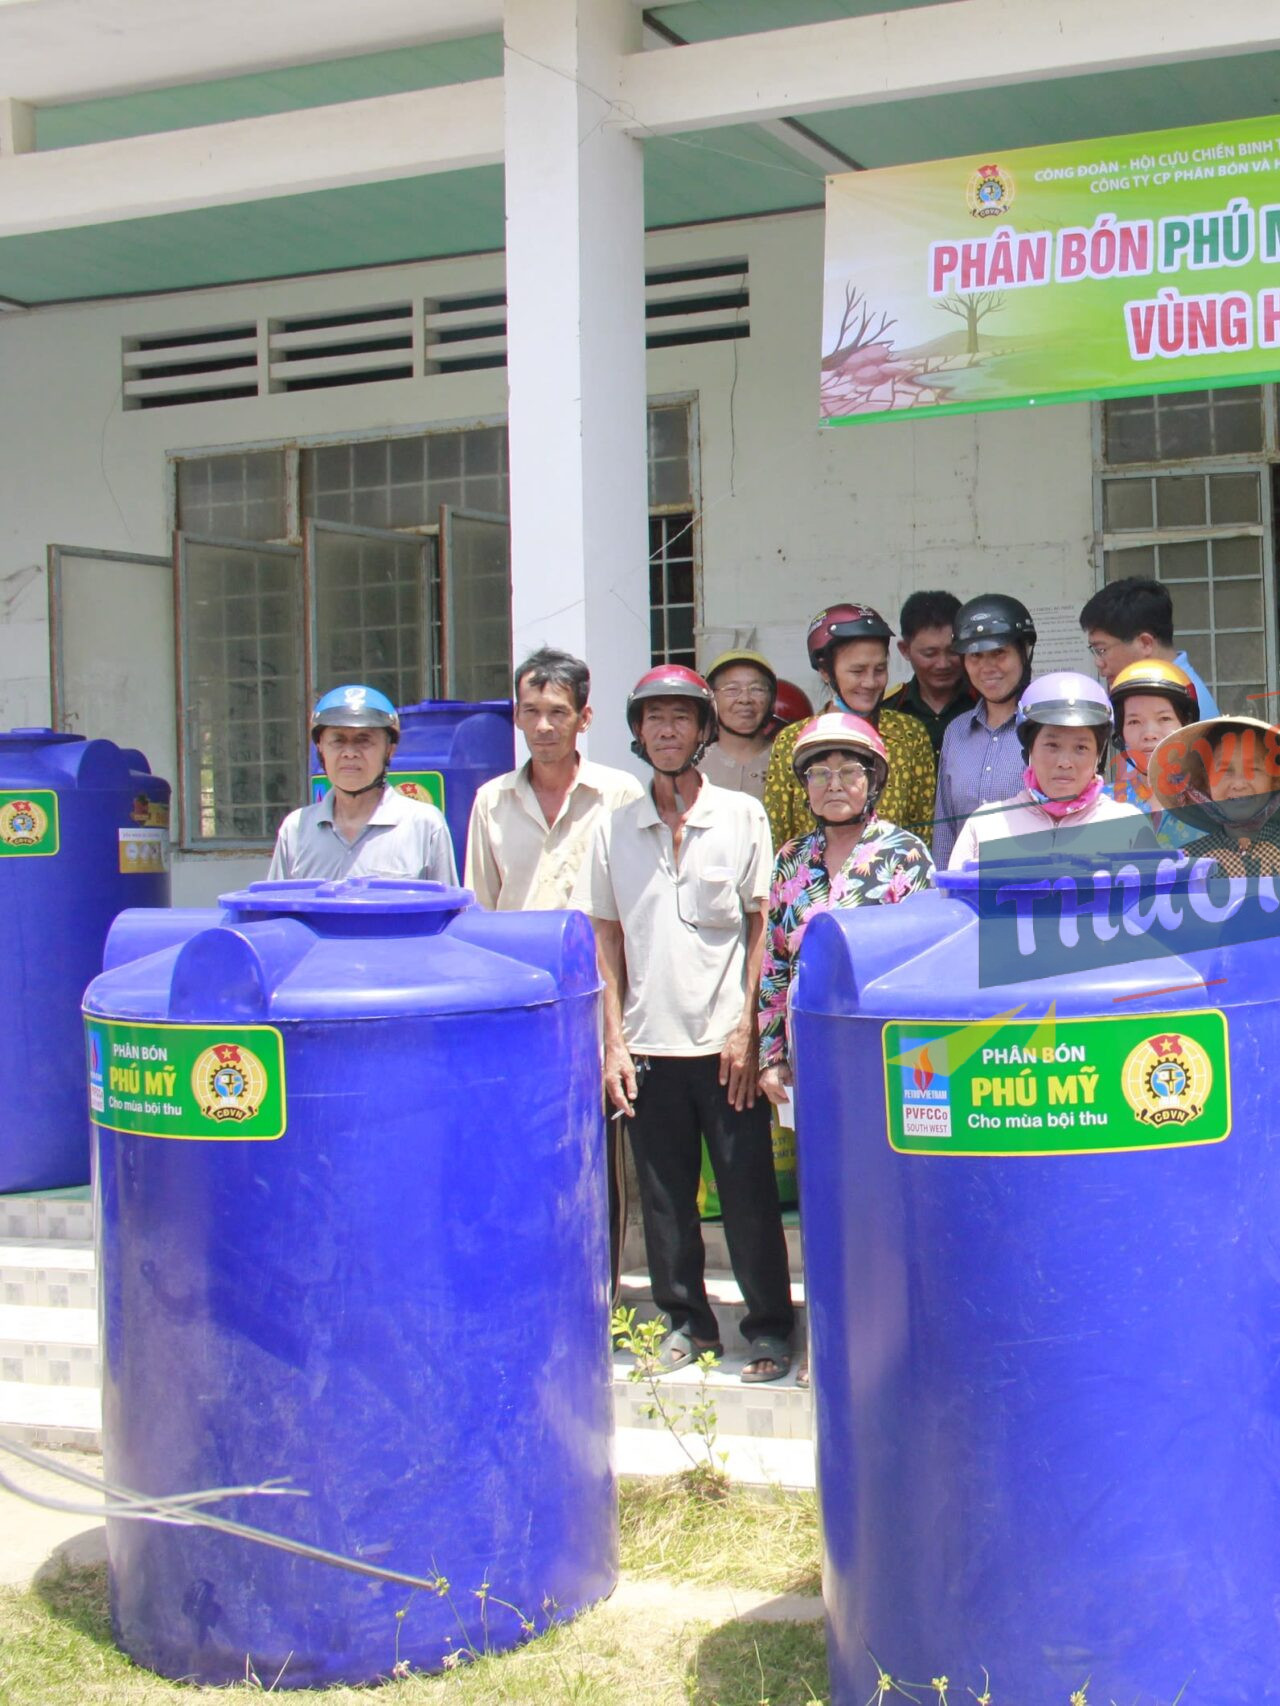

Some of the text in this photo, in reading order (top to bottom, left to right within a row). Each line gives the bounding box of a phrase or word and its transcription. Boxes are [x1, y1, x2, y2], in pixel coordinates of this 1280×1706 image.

[1034, 166, 1074, 182] CÔNG
[1077, 160, 1119, 178] ĐOÀN
[1130, 155, 1155, 171] HỘI
[1158, 150, 1189, 167] CỰU
[1192, 143, 1235, 163] CHIẾN
[1238, 139, 1274, 157] BINH
[1090, 176, 1130, 194] CÔNG
[1133, 173, 1151, 188] TY
[1153, 171, 1171, 187] CP
[1174, 164, 1215, 183] PHÂN
[1218, 159, 1249, 178] BÓN
[1252, 156, 1271, 173] VÀ
[932, 225, 1048, 293] PHÂN
[1060, 218, 1149, 278] BÓN
[1163, 203, 1250, 268] PHÚ
[1129, 293, 1248, 355] VÙNG
[112, 1042, 168, 1062] PHÂN BÓN
[982, 1044, 1086, 1065] PHÂN BÓN
[109, 1062, 177, 1097] PHÚ MỸ
[970, 1065, 1100, 1107] PHÚ MỸ
[108, 1096, 123, 1109] Cho
[123, 1099, 143, 1112] mùa
[144, 1101, 161, 1115] bội
[163, 1103, 183, 1116] thu
[216, 1108, 244, 1121] CĐVN
[905, 1107, 948, 1121] PVFCCo
[1154, 1109, 1186, 1122] CĐVN
[906, 1123, 948, 1133] SOUTH WEST
[968, 1110, 1108, 1130] Cho mùa bội thu
